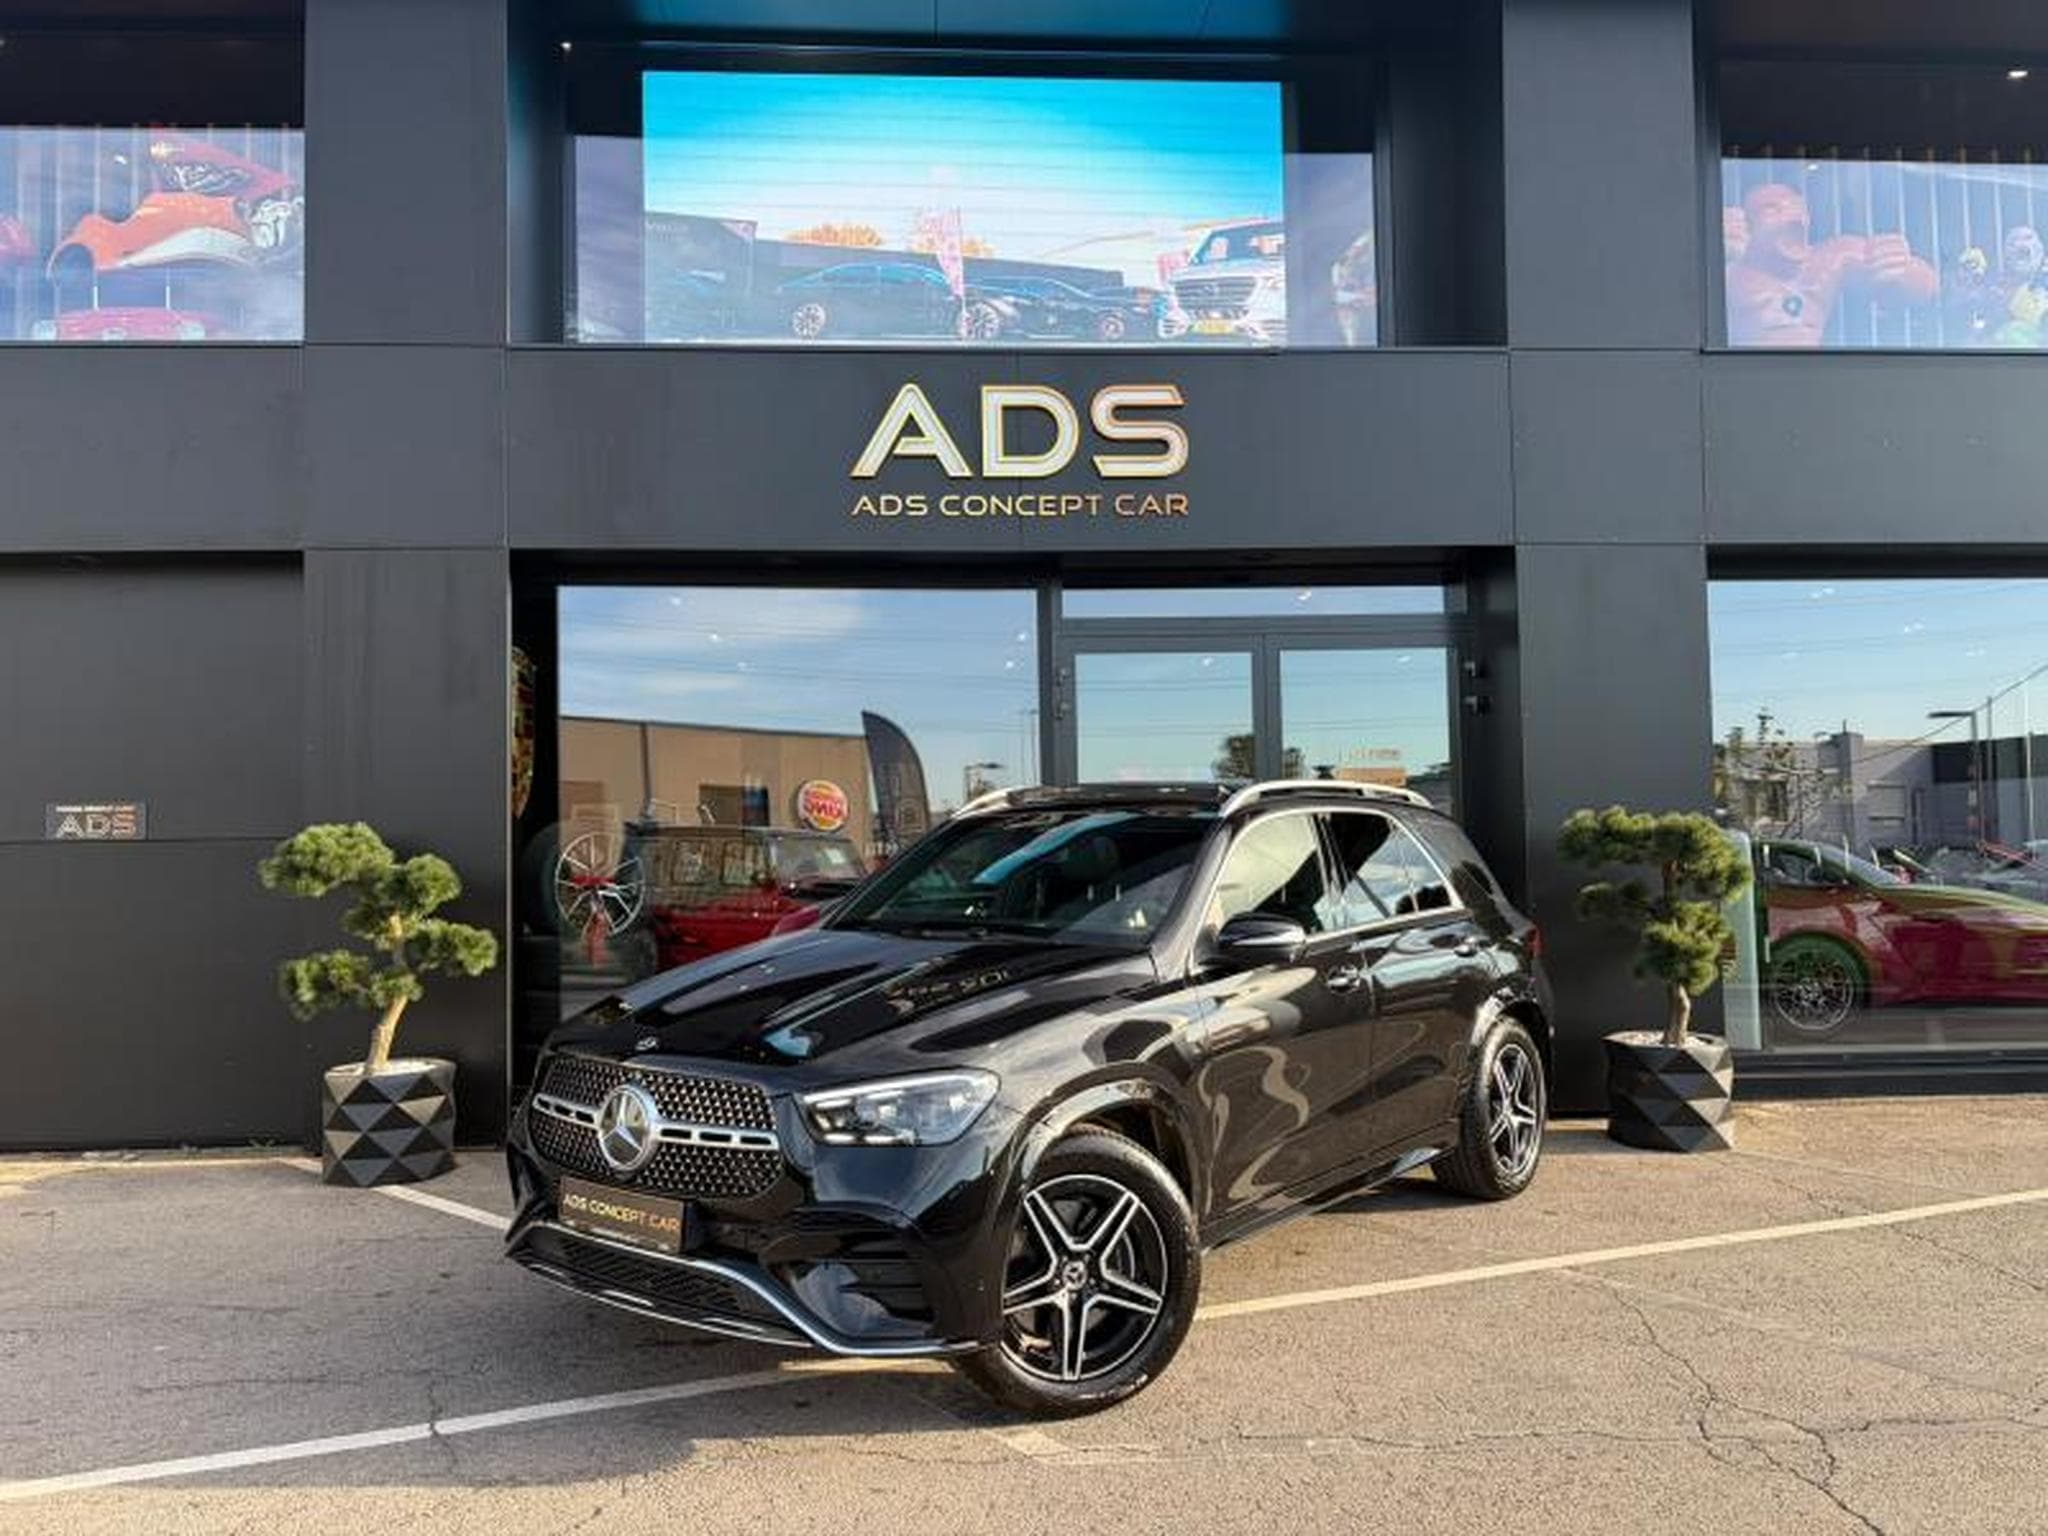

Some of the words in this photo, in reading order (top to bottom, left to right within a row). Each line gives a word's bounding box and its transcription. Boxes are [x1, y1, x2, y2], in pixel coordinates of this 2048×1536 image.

[850, 382, 1190, 478] ADS
[851, 495, 928, 516] ADS
[939, 495, 1103, 516] CONCEPT
[1114, 494, 1190, 516] CAR
[55, 813, 138, 839] ADS
[563, 1193, 587, 1210] ADS
[589, 1200, 646, 1224] CONCEPT
[650, 1214, 679, 1231] CAR
